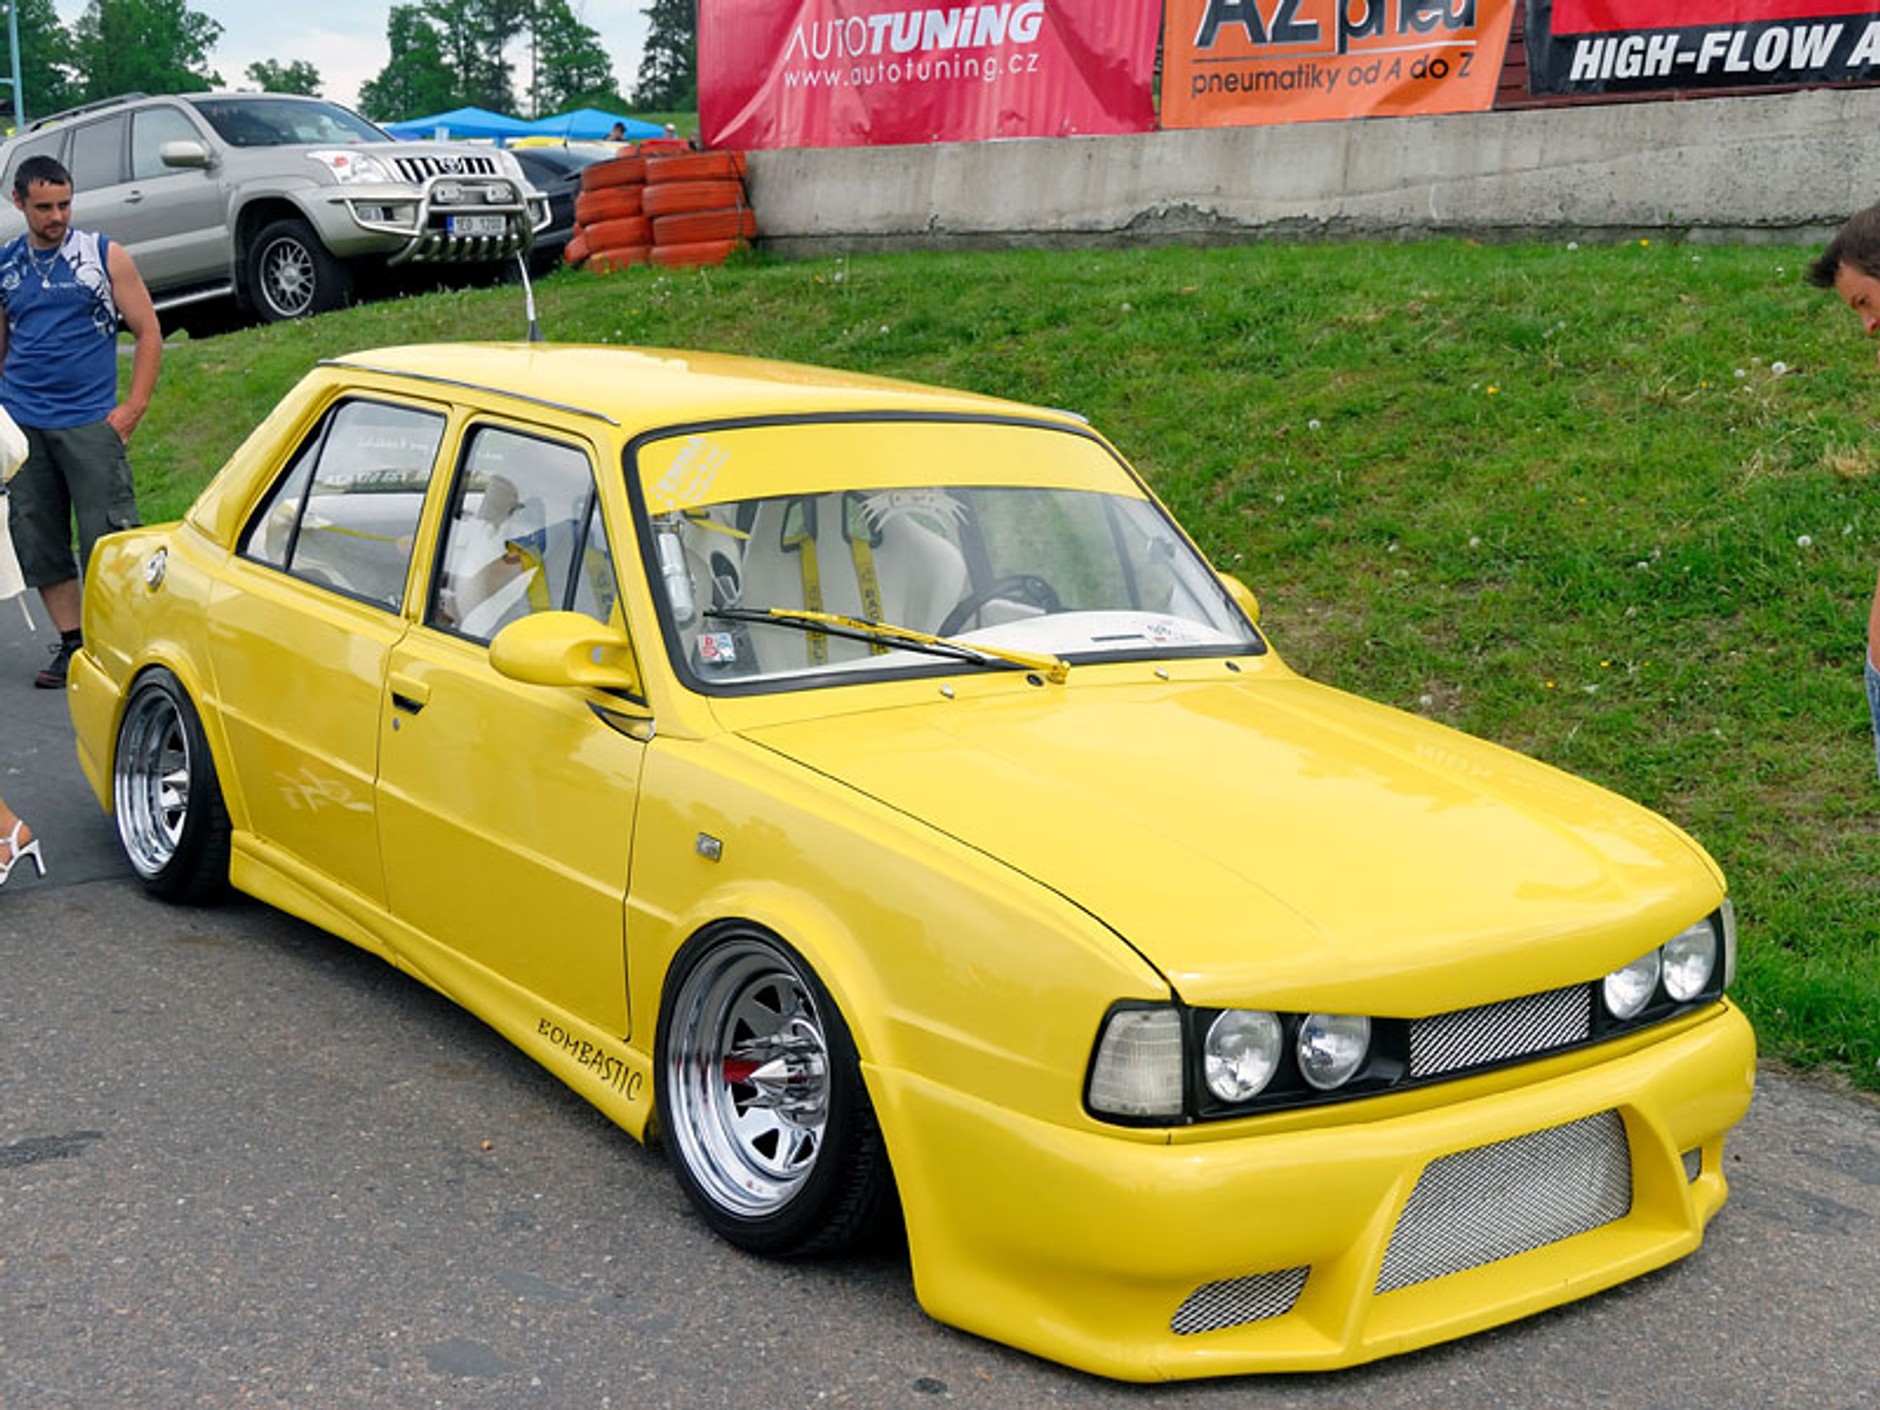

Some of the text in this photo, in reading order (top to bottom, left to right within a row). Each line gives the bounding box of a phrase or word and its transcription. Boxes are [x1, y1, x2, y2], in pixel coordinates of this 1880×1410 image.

[785, 53, 1039, 87] www.autotuning.cz
[1191, 52, 1475, 99] pneumatiky od A do Z
[1570, 24, 1844, 81] HIGH-FLOW
[537, 1017, 643, 1102] BOMBASTIC
